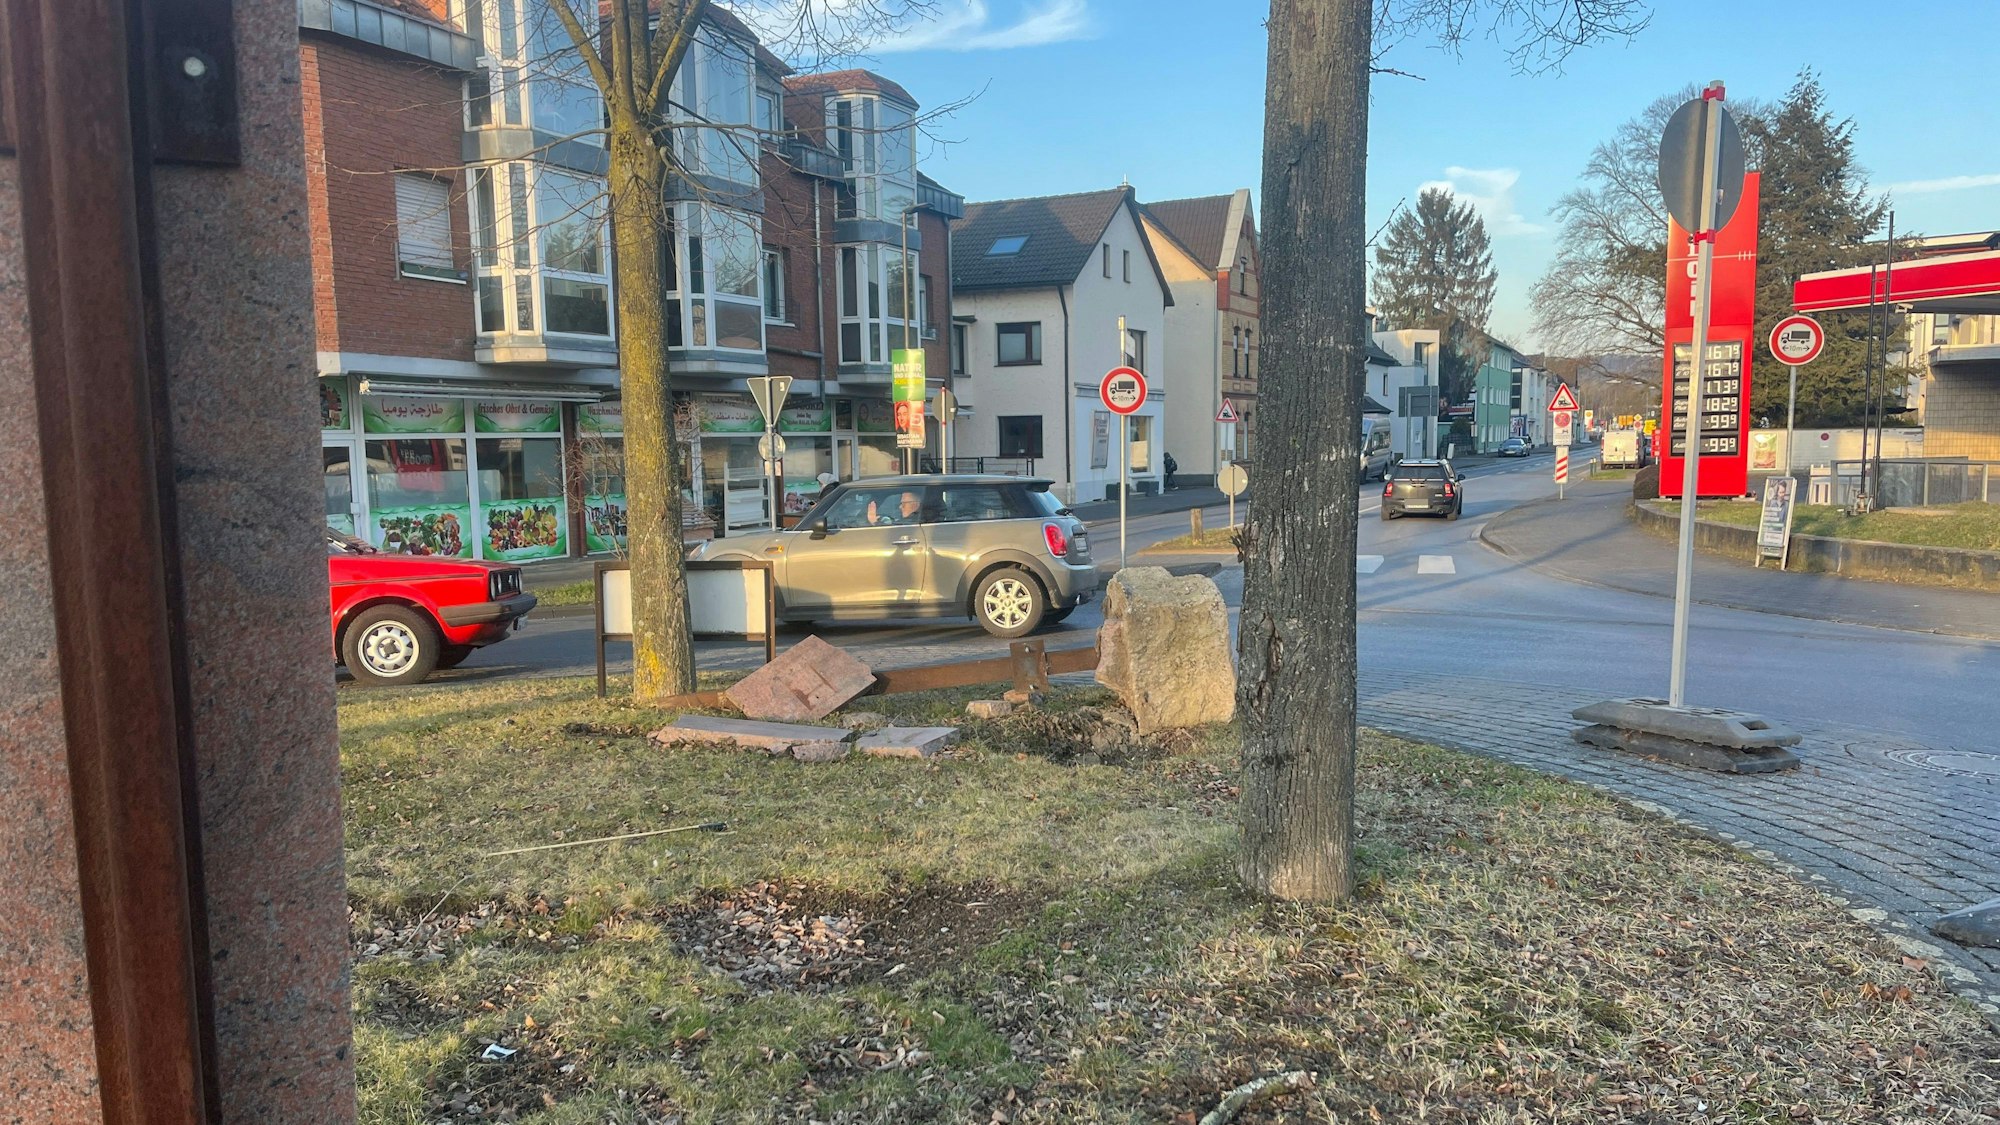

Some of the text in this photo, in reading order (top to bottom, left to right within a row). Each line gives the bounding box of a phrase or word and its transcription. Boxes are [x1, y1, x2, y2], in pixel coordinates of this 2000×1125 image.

[505, 403, 521, 414] Obst
[521, 404, 528, 414] &
[529, 403, 555, 414] Gemüse
